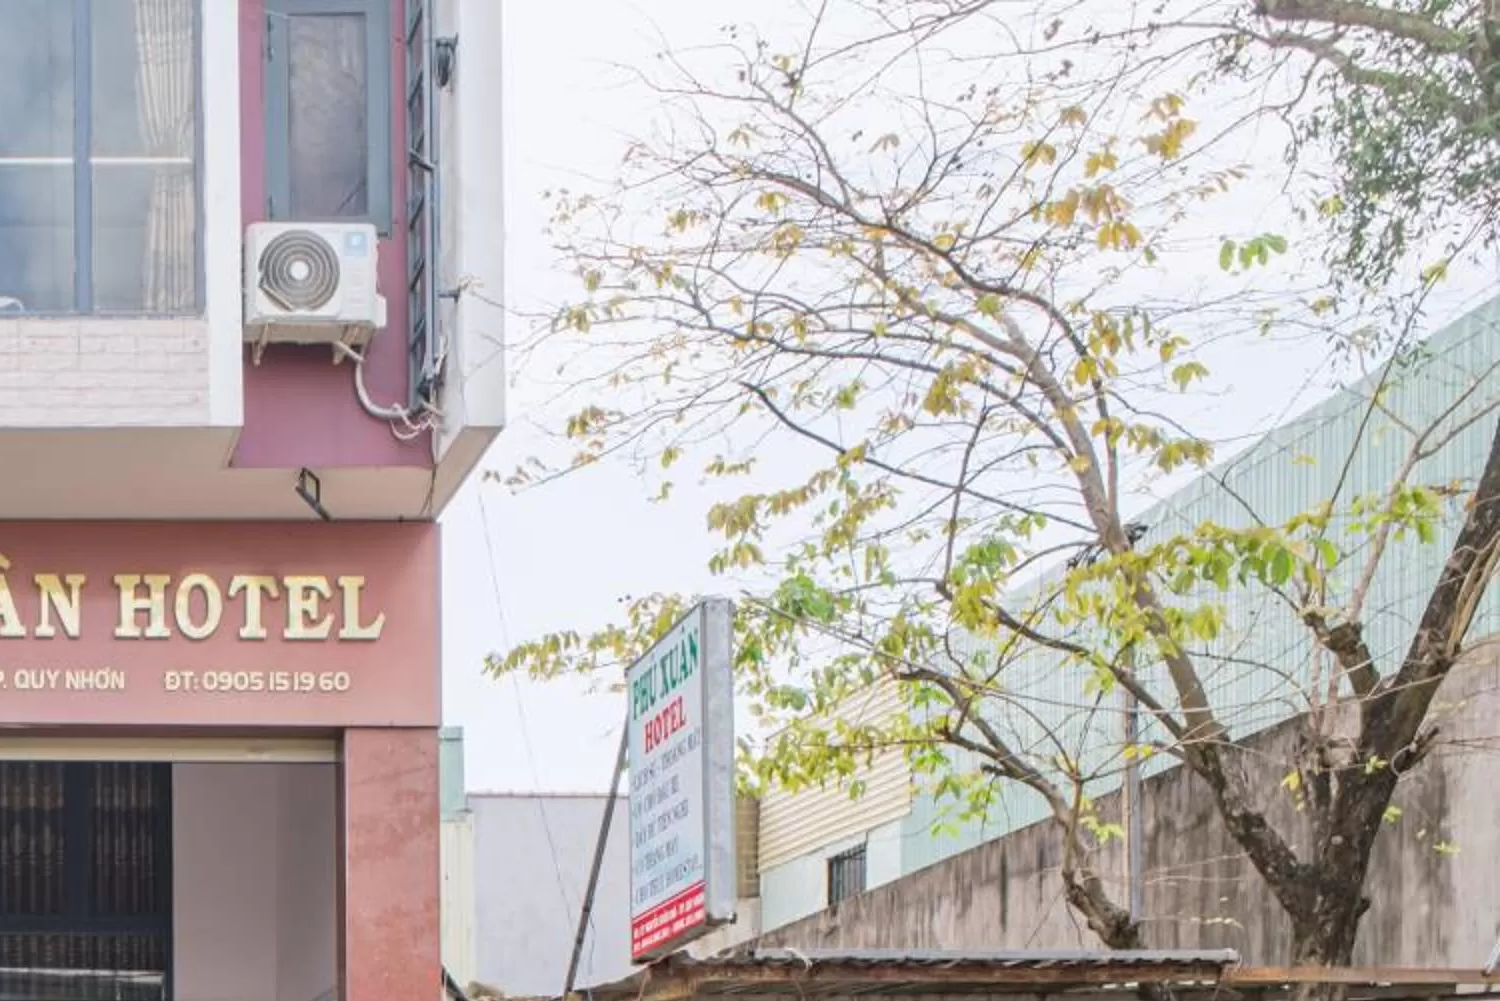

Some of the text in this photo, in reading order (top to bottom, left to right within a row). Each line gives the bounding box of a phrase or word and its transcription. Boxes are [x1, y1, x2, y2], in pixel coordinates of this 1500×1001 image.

[113, 573, 387, 642] HOTEL
[14, 669, 61, 690] QUY
[65, 666, 126, 690] NHƠN
[164, 670, 200, 691] ĐT:
[643, 695, 688, 755] HOTEL
